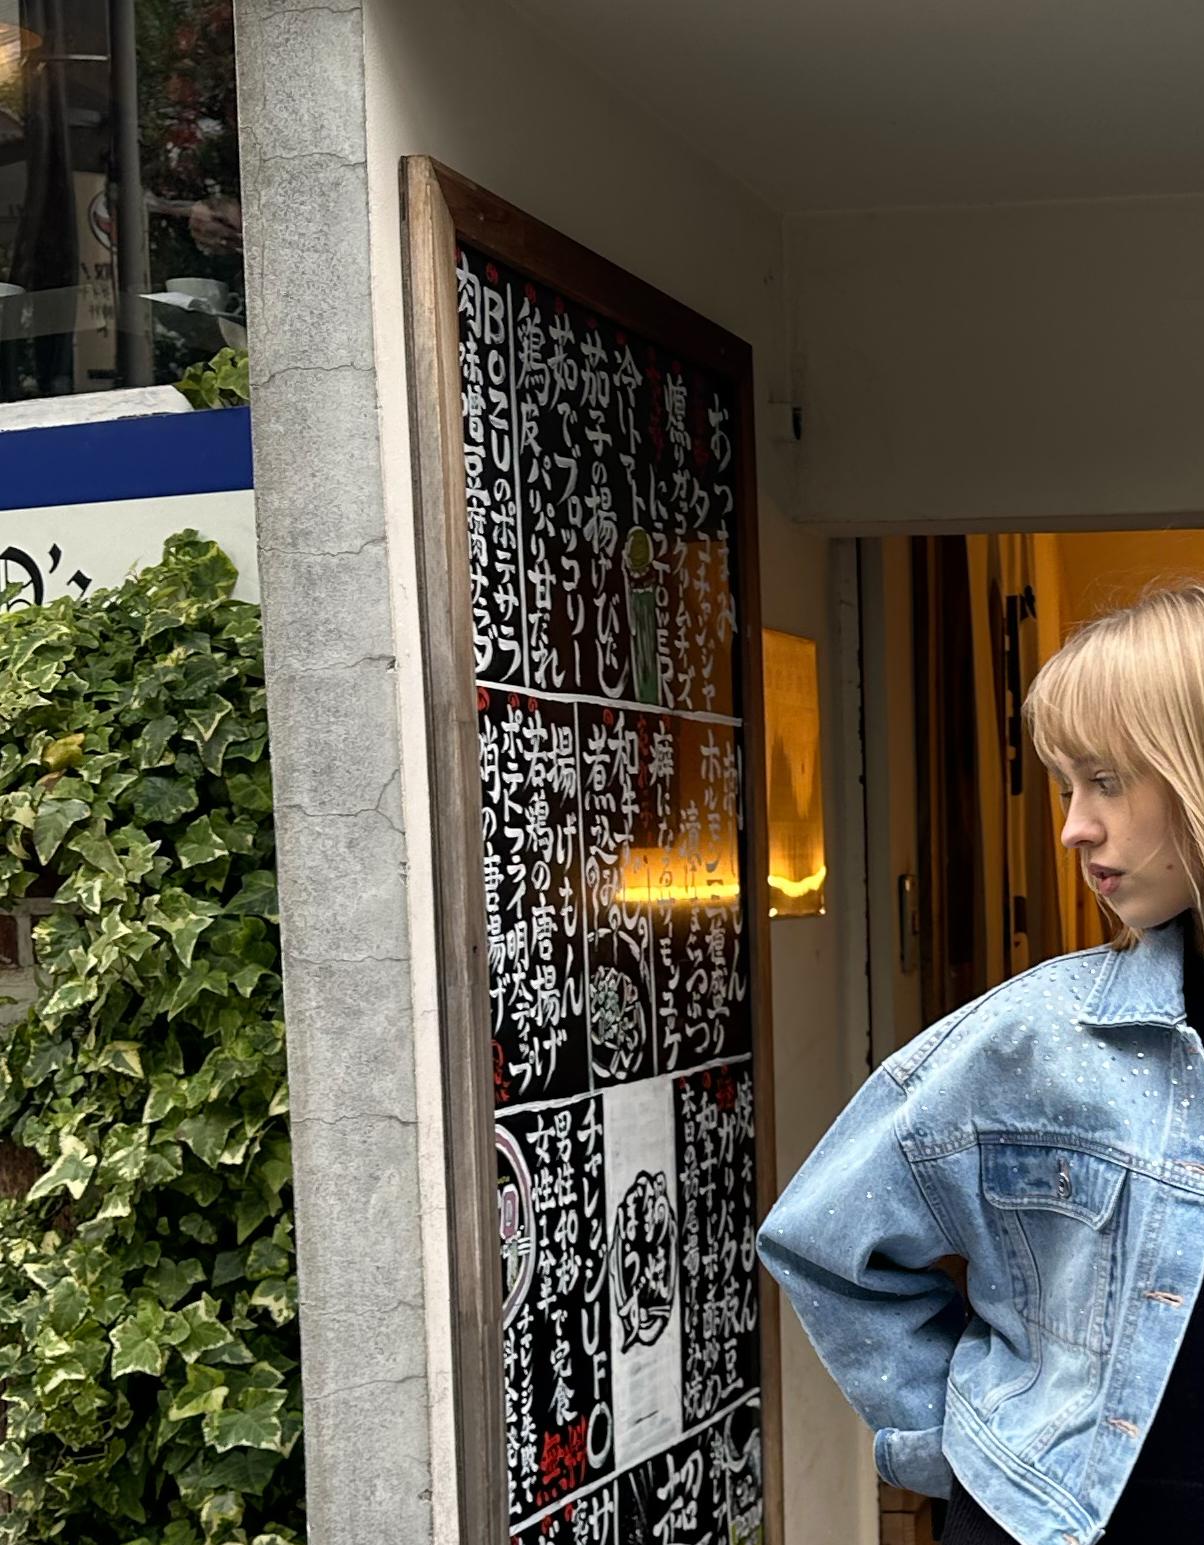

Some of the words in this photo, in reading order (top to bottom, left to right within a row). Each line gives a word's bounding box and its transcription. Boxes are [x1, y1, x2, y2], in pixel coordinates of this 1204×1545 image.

[547, 312, 584, 688] 茹でブロッコリー
[579, 328, 632, 699] 茄子の揚げびたし
